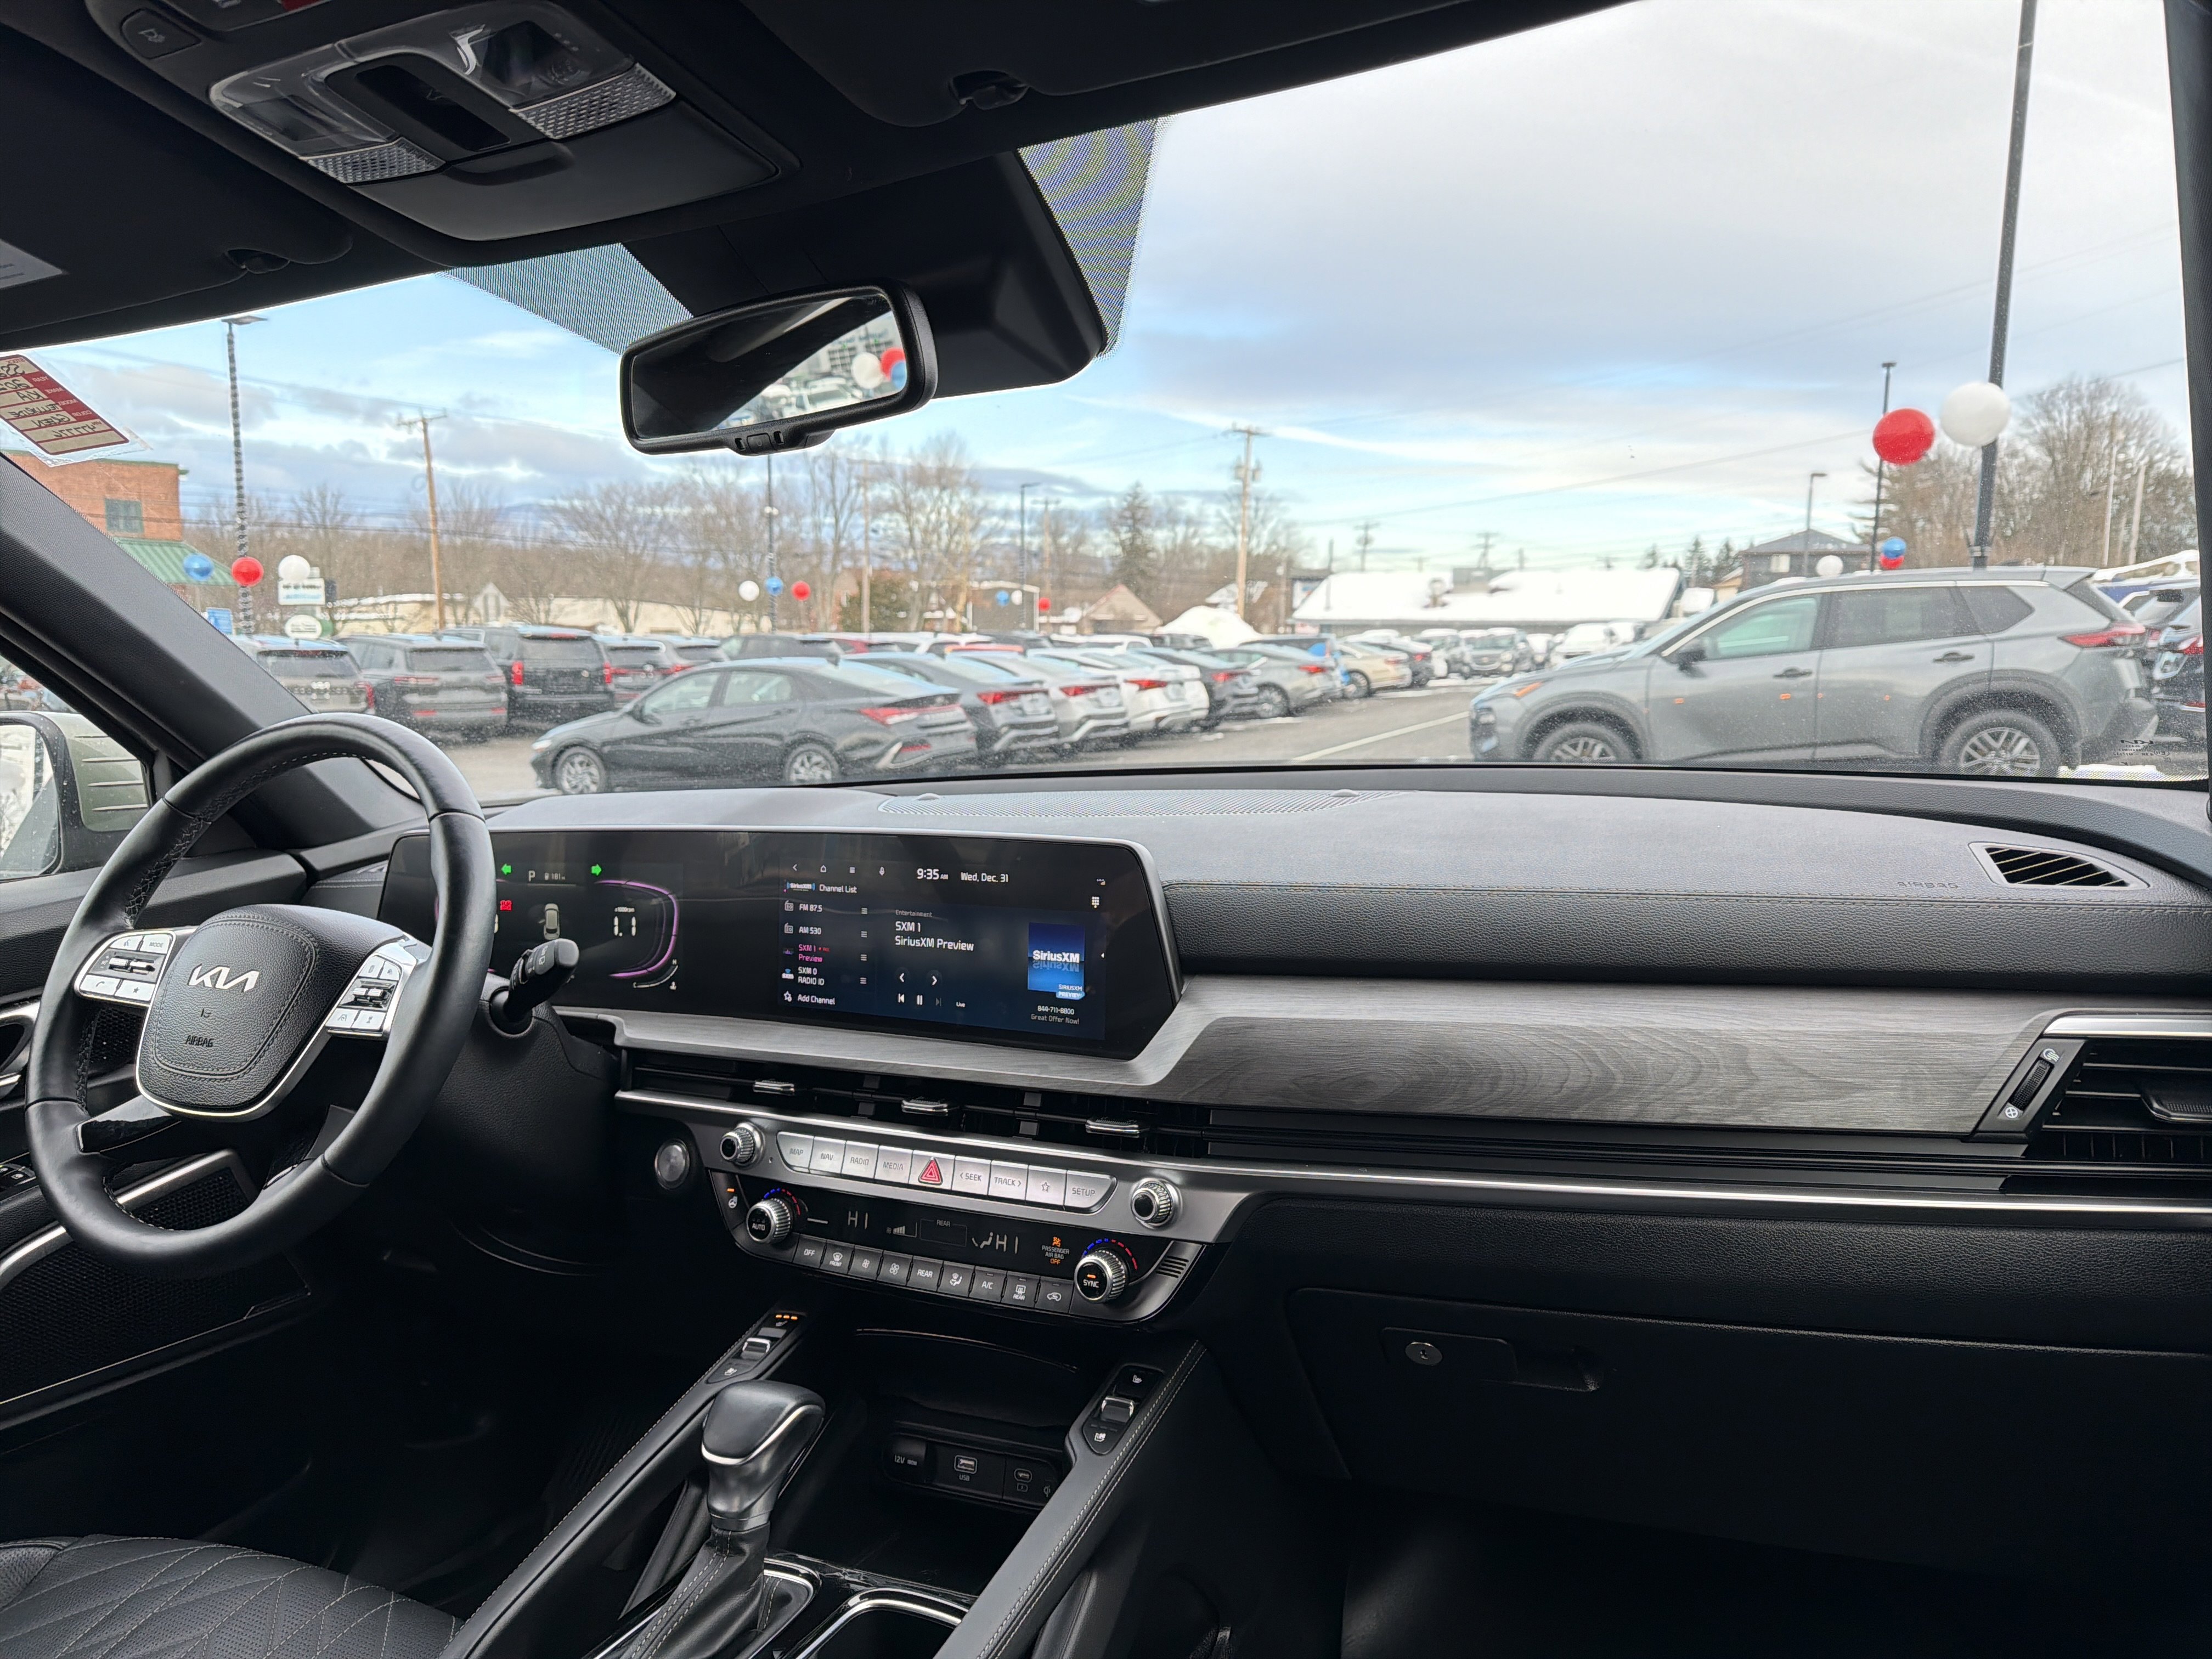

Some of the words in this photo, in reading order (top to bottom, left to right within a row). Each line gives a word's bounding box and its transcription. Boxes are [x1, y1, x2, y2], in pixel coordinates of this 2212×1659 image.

[528, 871, 535, 882] P
[917, 868, 939, 879] 9:35
[1000, 874, 1008, 882] 31
[819, 884, 844, 893] Channel
[895, 921, 915, 932] SXM
[918, 923, 921, 932] 1
[895, 935, 934, 947] SiriusXM
[937, 939, 974, 951] Preview
[798, 953, 823, 962] Preview
[1032, 950, 1080, 963] SiriusXM
[187, 963, 259, 992] KIA
[798, 977, 816, 985] RADIO
[811, 996, 835, 1005] Channel
[1037, 1006, 1074, 1014] 844-711-8800
[185, 1035, 214, 1047] AIRBAG
[850, 1157, 869, 1165] RADIO
[883, 1161, 903, 1170] MEDIA
[965, 1172, 982, 1181] SEEK
[994, 1177, 1015, 1186] TRACK
[1072, 1187, 1095, 1197] SETUP
[752, 1223, 765, 1231] AUTO
[1041, 1245, 1070, 1254] PASSENGER
[917, 1269, 933, 1278] REAR
[981, 1281, 994, 1290] A/C
[1083, 1279, 1099, 1288] SYNC
[894, 1455, 905, 1464] 12V
